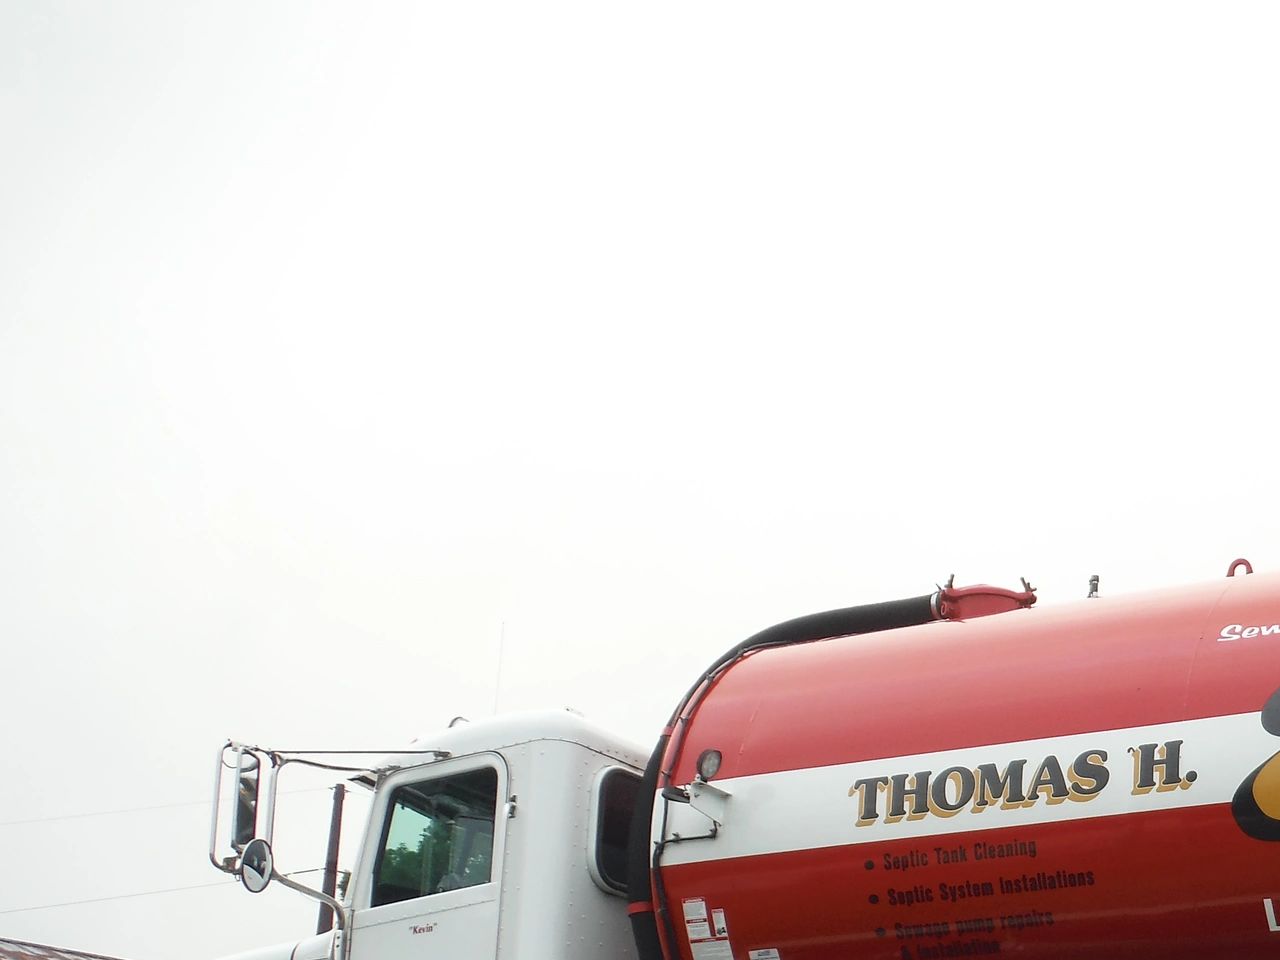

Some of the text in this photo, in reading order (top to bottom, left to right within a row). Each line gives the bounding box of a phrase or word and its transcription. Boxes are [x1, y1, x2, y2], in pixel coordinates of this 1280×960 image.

[849, 749, 1111, 827] THOMAS
[1127, 740, 1198, 795] H.
[883, 838, 1038, 872] Septic Tank Cleaning
[887, 870, 1095, 907] Septic System Installations
[1000, 910, 1054, 929] repairs
